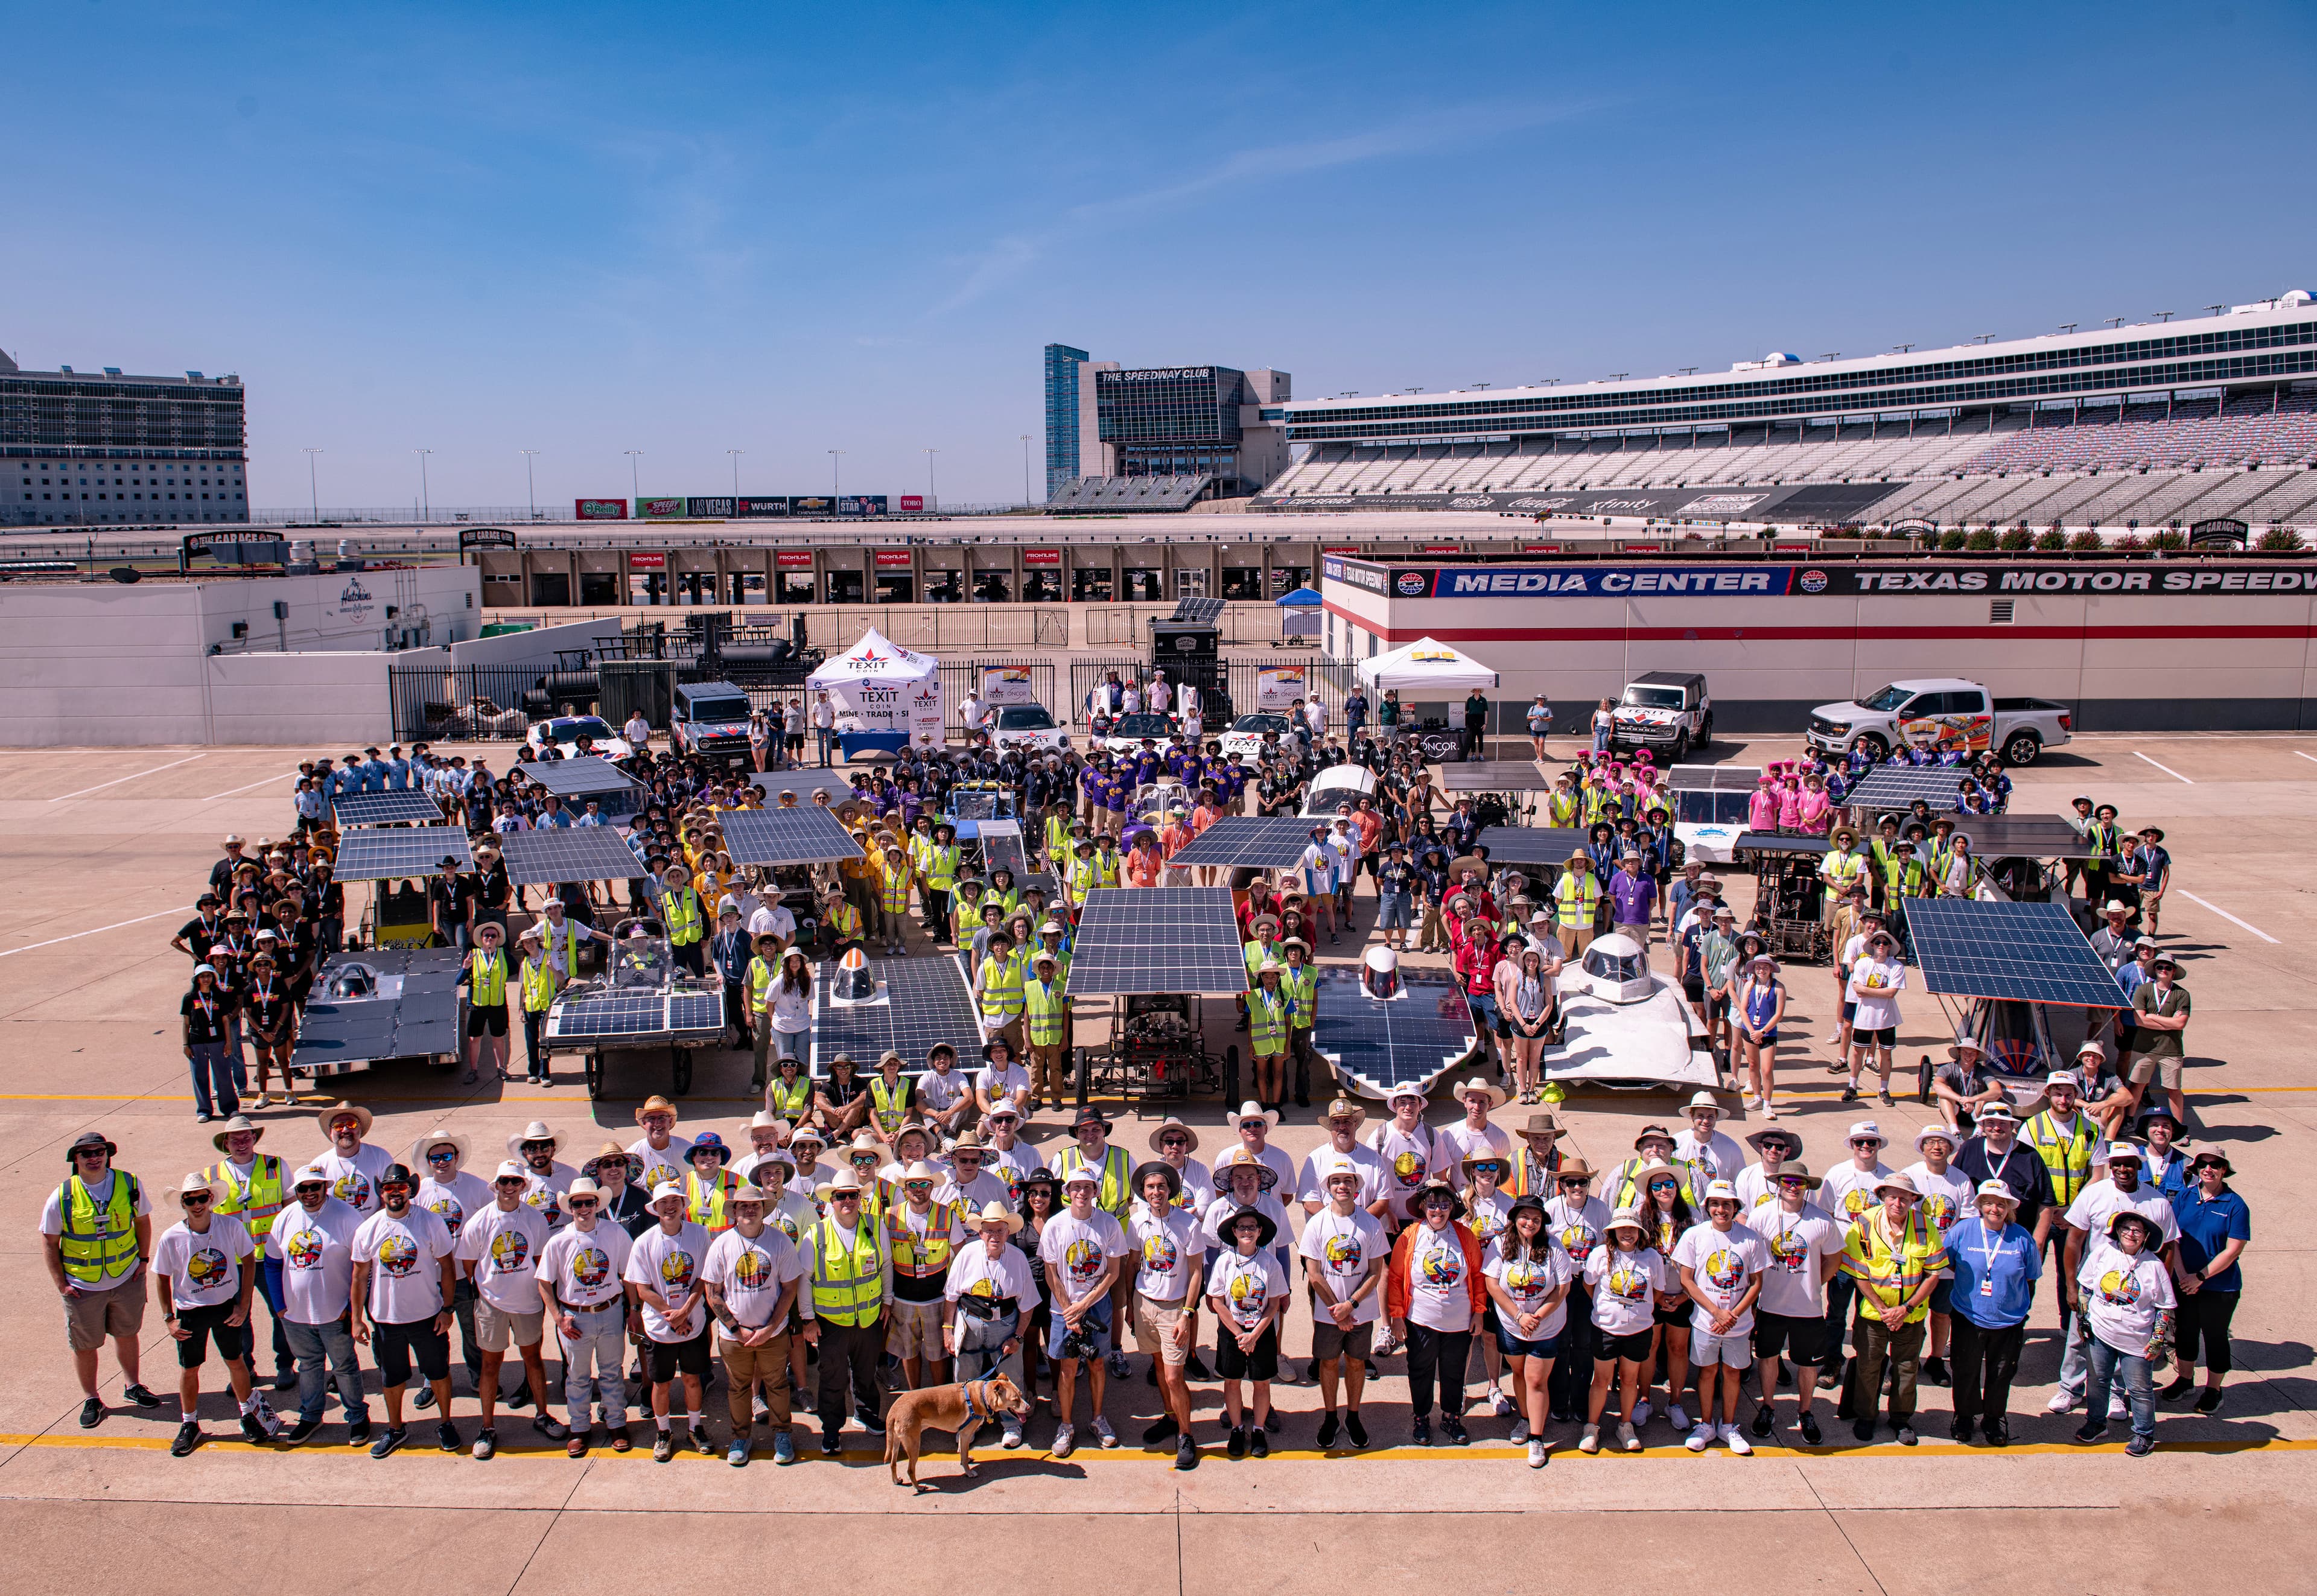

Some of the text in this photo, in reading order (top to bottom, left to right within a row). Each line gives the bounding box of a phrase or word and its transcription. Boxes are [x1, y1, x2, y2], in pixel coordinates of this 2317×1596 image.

[1102, 368, 1209, 382] THE SPEEDWAY CLUB
[652, 500, 679, 509] SPEEDY
[692, 499, 731, 515] LAS VEGAS
[841, 502, 859, 512] STAR
[1449, 497, 1495, 507] BUSCH
[1585, 498, 1659, 511] xfinity
[583, 501, 621, 517] O'Reilly
[1903, 519, 1924, 528] GARAGE
[2206, 521, 2235, 533] GARAGE
[199, 535, 214, 545] TEXAS
[214, 533, 258, 543] GARAGE
[477, 530, 500, 540] GARAGE
[1332, 562, 1342, 577] CENTER
[1346, 567, 1383, 590] TEXAS MOTOR SPEEDWAY
[1454, 573, 1770, 592] MEDIA CENTER
[1854, 572, 1989, 590] TEXAS
[2000, 572, 2153, 590] MOTOR
[341, 587, 372, 606] Hutchins
[987, 673, 1000, 682] 2025
[1260, 674, 1275, 683] 2025
[859, 691, 900, 703] TEXIT
[417, 932, 434, 950] X
[216, 1279, 232, 1288] Challenge
[598, 1282, 612, 1290] Challenge
